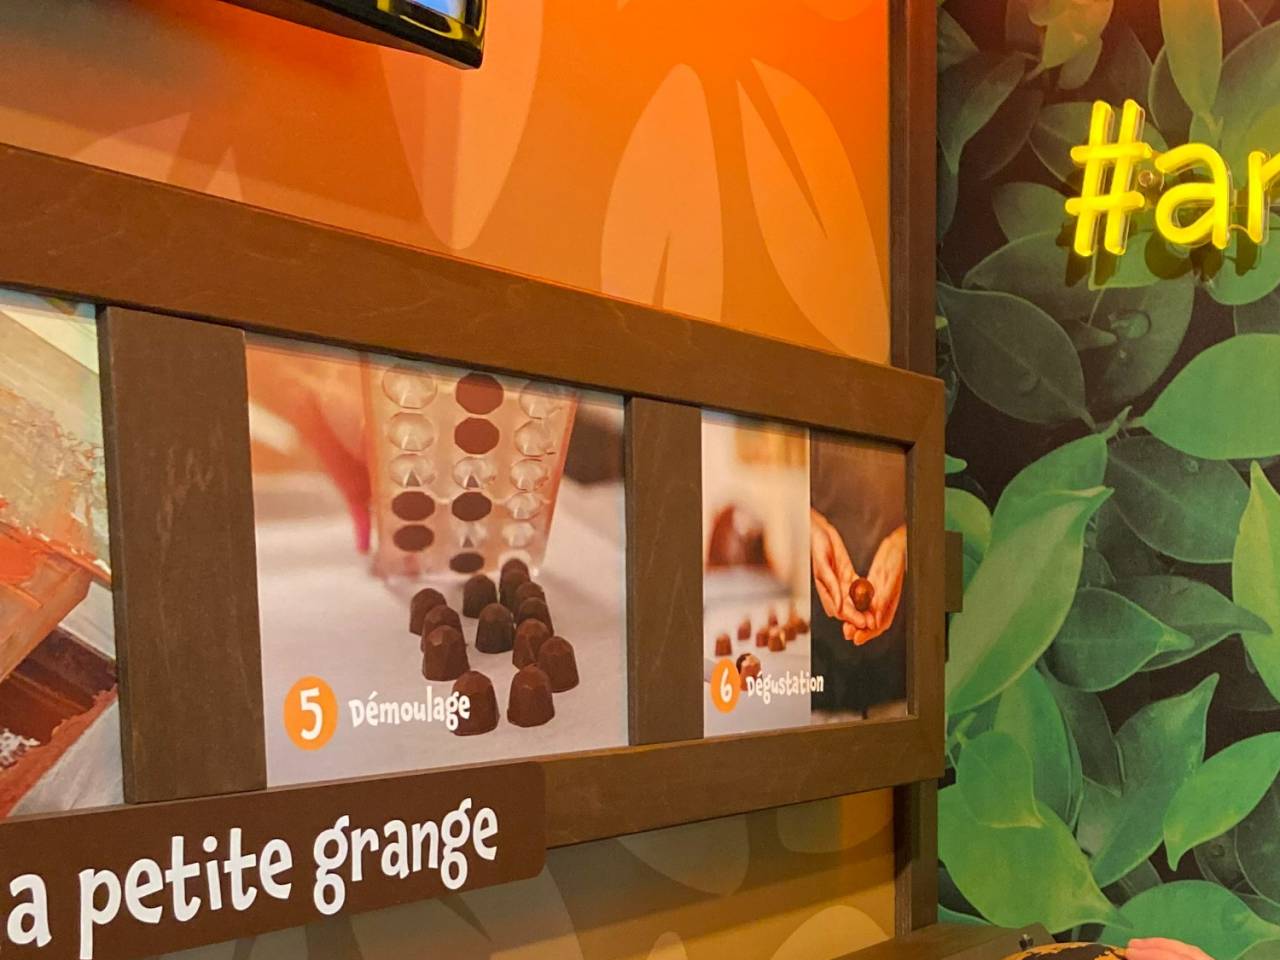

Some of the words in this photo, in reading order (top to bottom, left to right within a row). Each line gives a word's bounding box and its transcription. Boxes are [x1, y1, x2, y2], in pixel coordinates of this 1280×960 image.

[299, 687, 323, 741] 5
[348, 685, 471, 732] Démoulage
[720, 667, 733, 703] 6
[745, 669, 824, 705] Dégustation
[78, 828, 293, 960] petite
[313, 797, 499, 915] grange
